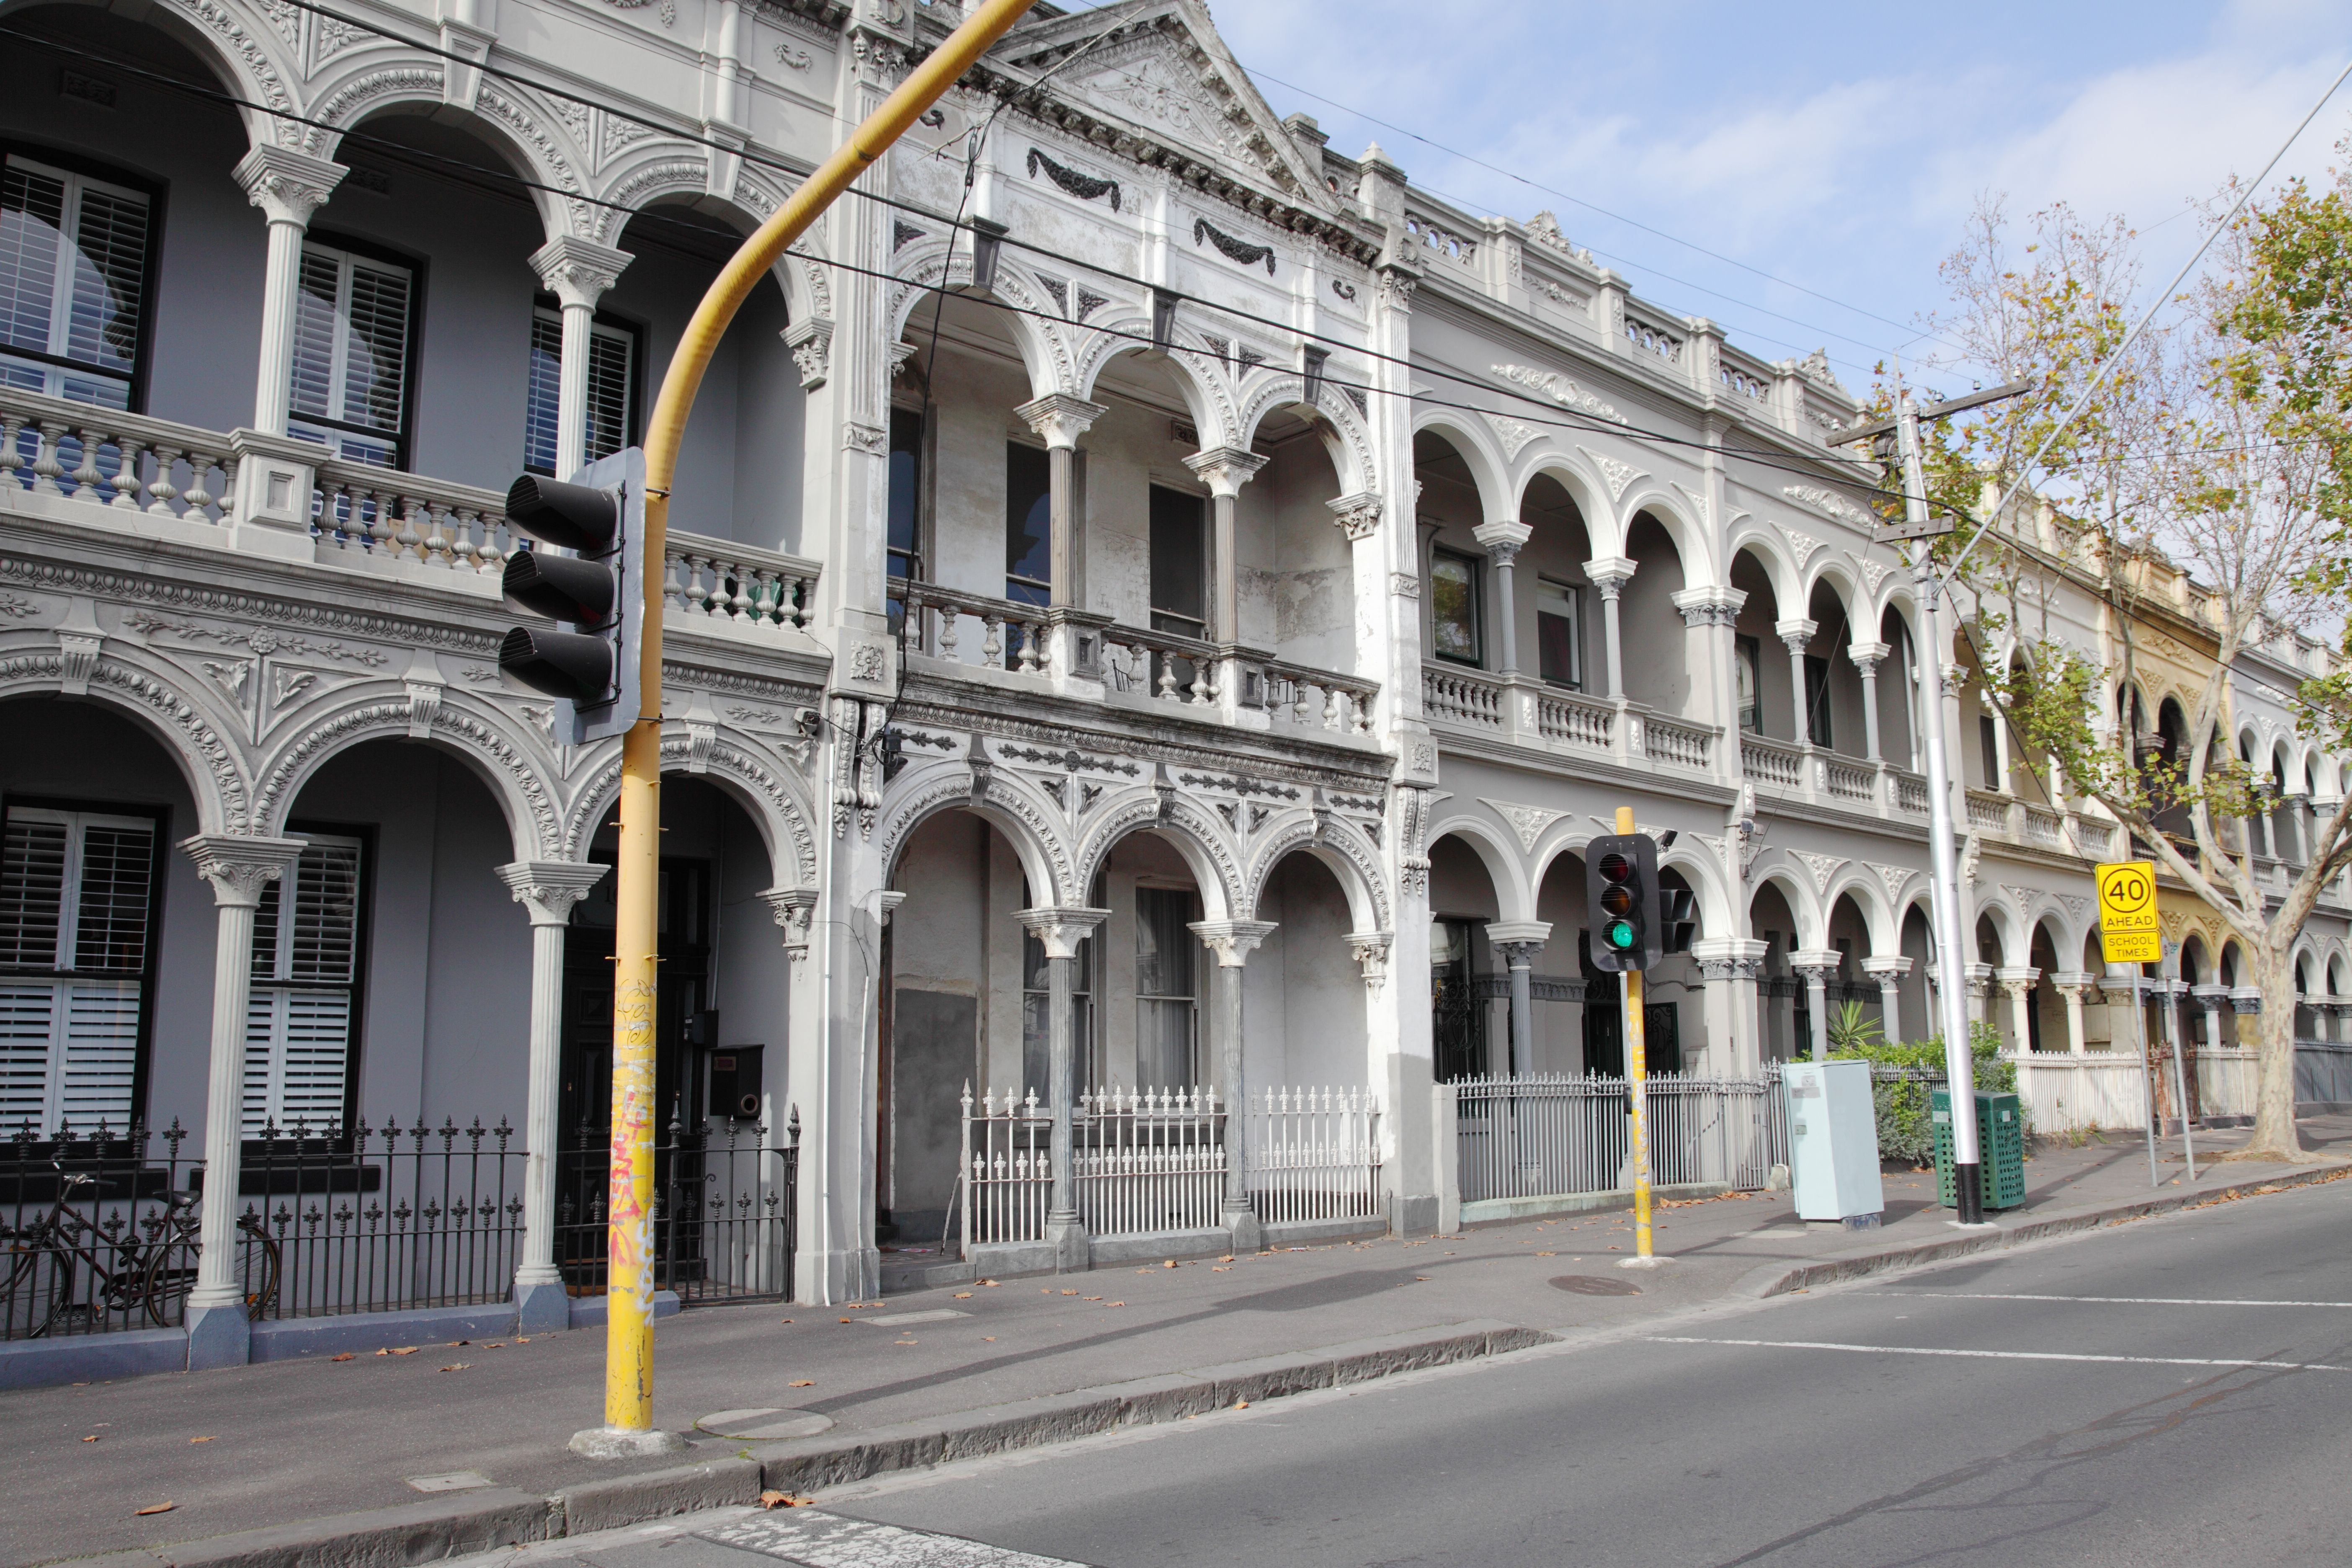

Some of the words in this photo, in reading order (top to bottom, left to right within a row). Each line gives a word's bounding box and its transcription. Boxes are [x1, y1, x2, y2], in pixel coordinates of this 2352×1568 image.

[2109, 879, 2143, 901] 40
[2106, 916, 2153, 927] AHEAD
[2109, 936, 2154, 946] SCHOOL
[2116, 948, 2148, 957] TIMES
[2170, 944, 2177, 953] 2P
